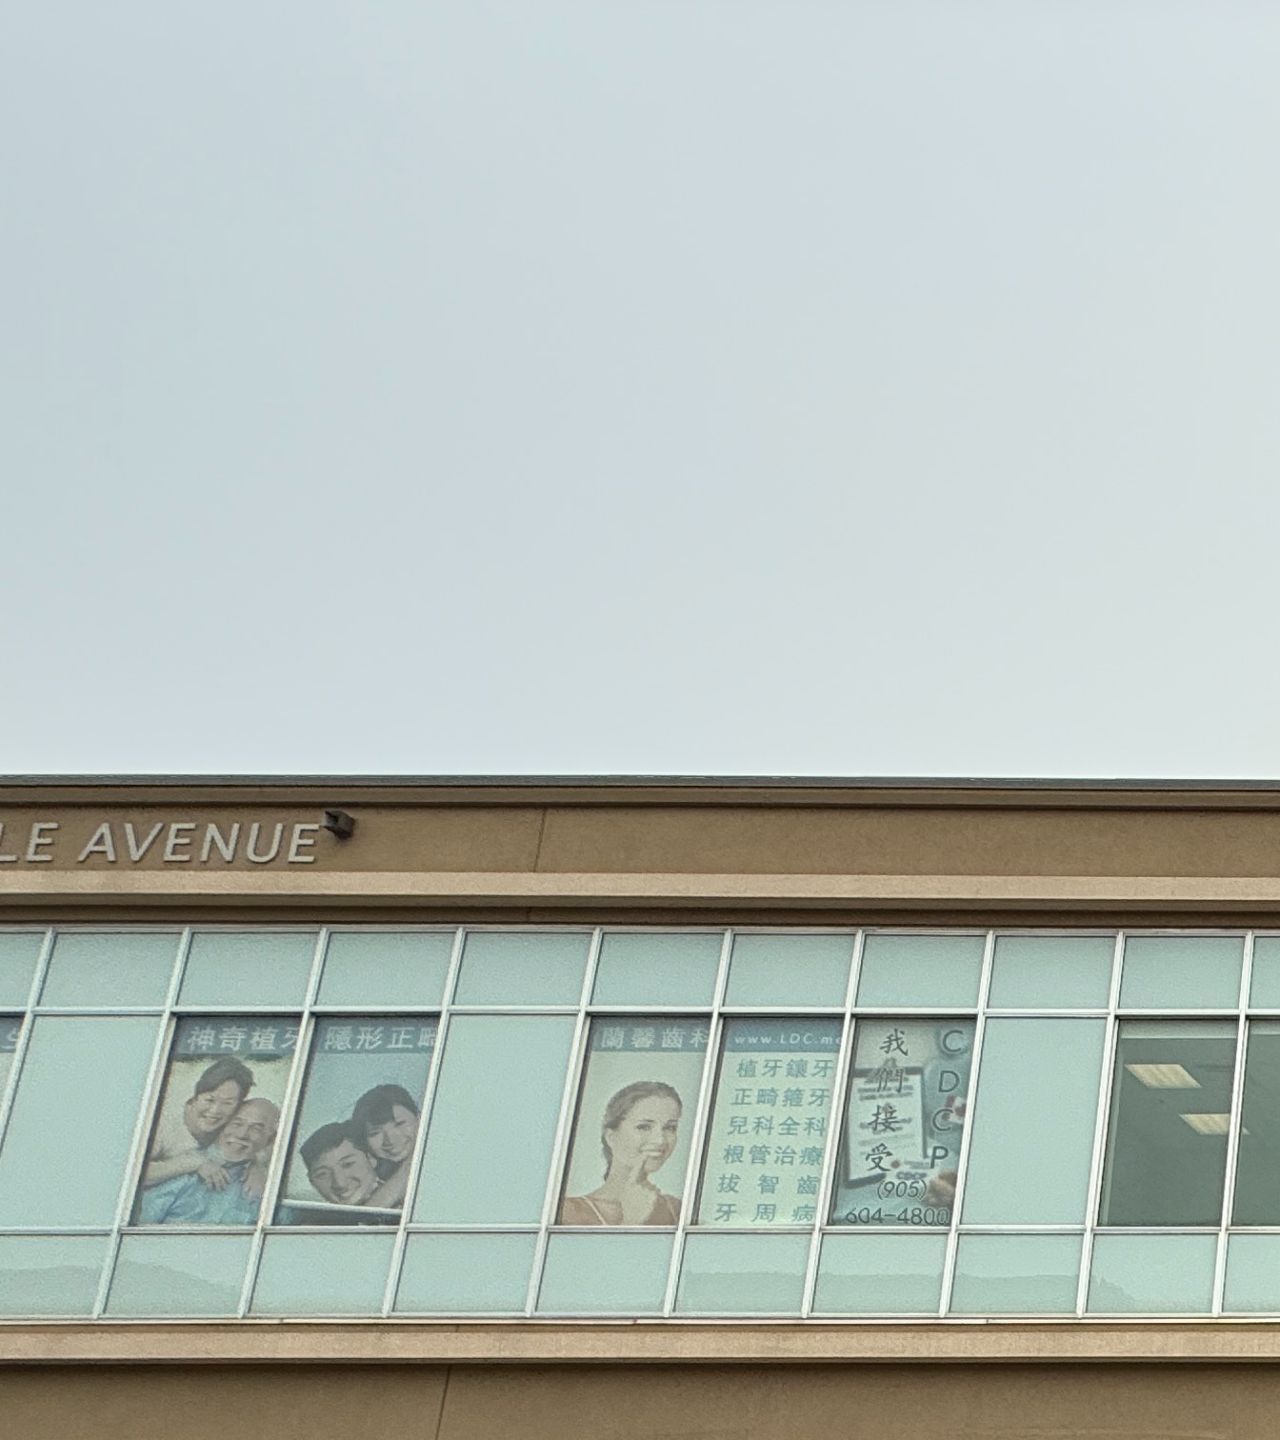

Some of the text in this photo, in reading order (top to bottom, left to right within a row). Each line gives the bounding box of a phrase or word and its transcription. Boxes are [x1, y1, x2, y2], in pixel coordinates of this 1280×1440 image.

[77, 822, 320, 863] AVENUE
[727, 1116, 825, 1137] 兒科全科
[723, 1144, 822, 1166] 根管治療
[877, 1180, 927, 1199] (905)
[845, 1207, 950, 1225] 604-4800
